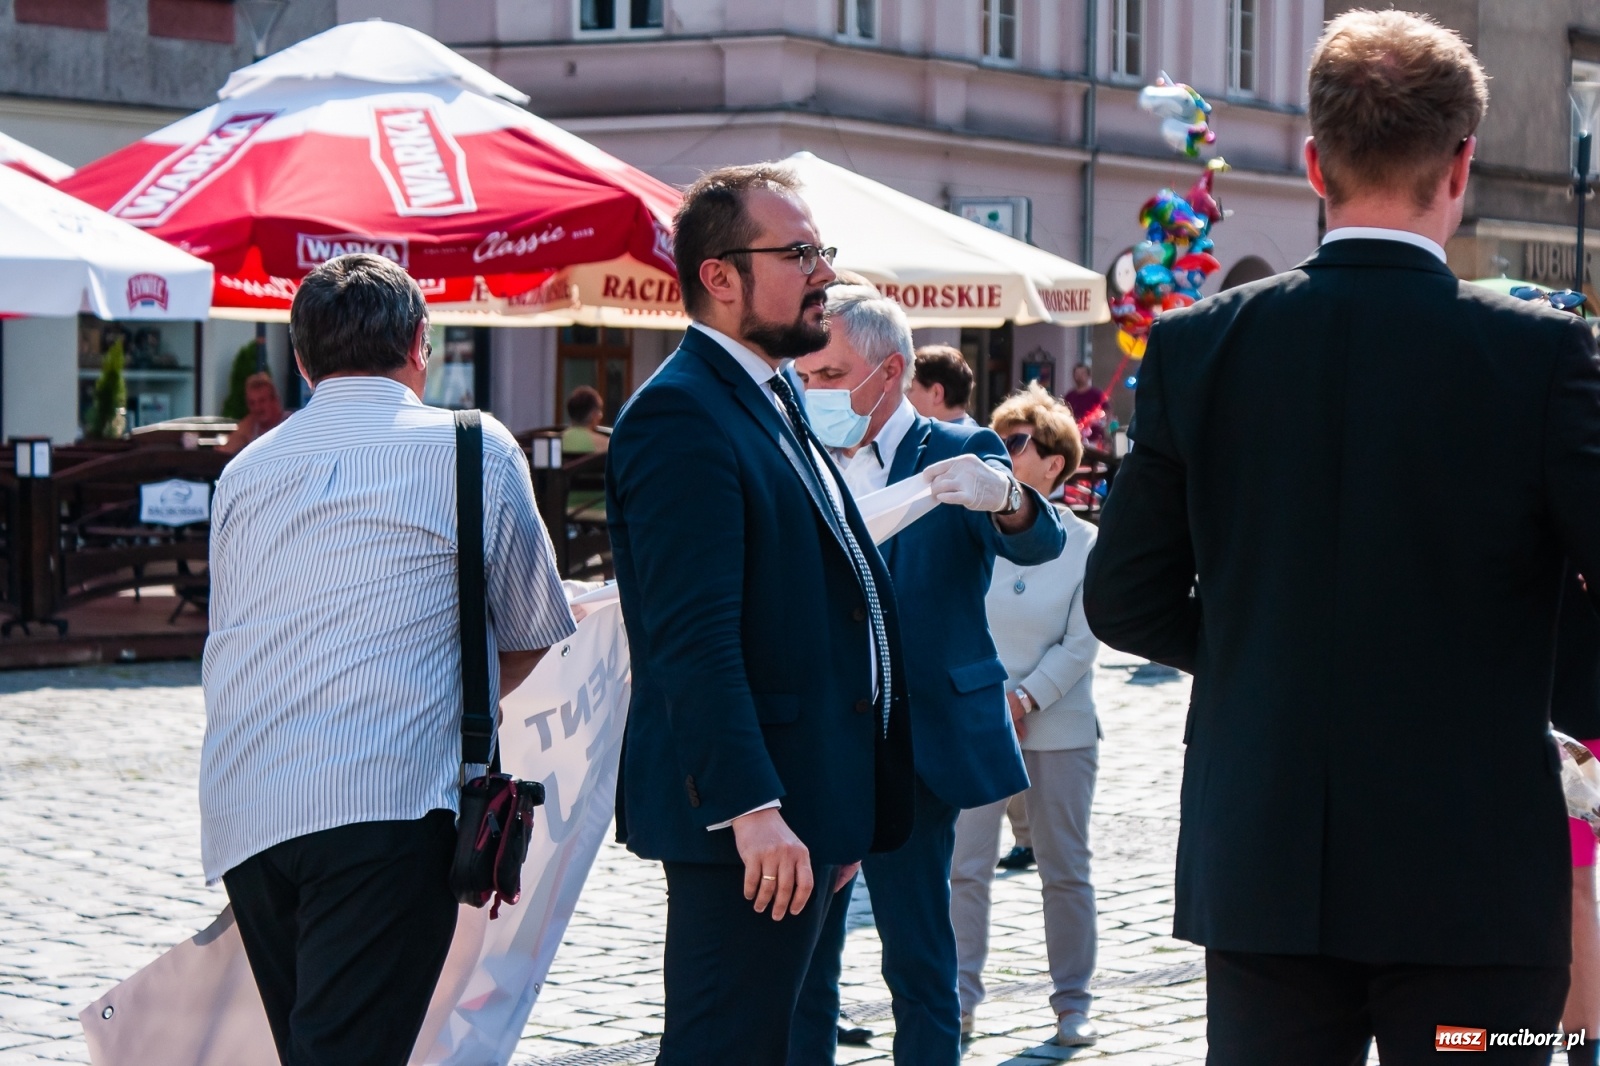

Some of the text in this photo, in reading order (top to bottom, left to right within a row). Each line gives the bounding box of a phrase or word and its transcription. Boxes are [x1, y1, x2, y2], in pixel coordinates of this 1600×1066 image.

[118, 116, 265, 208] WARKA
[381, 109, 456, 208] WARKA
[472, 222, 566, 264] Classic
